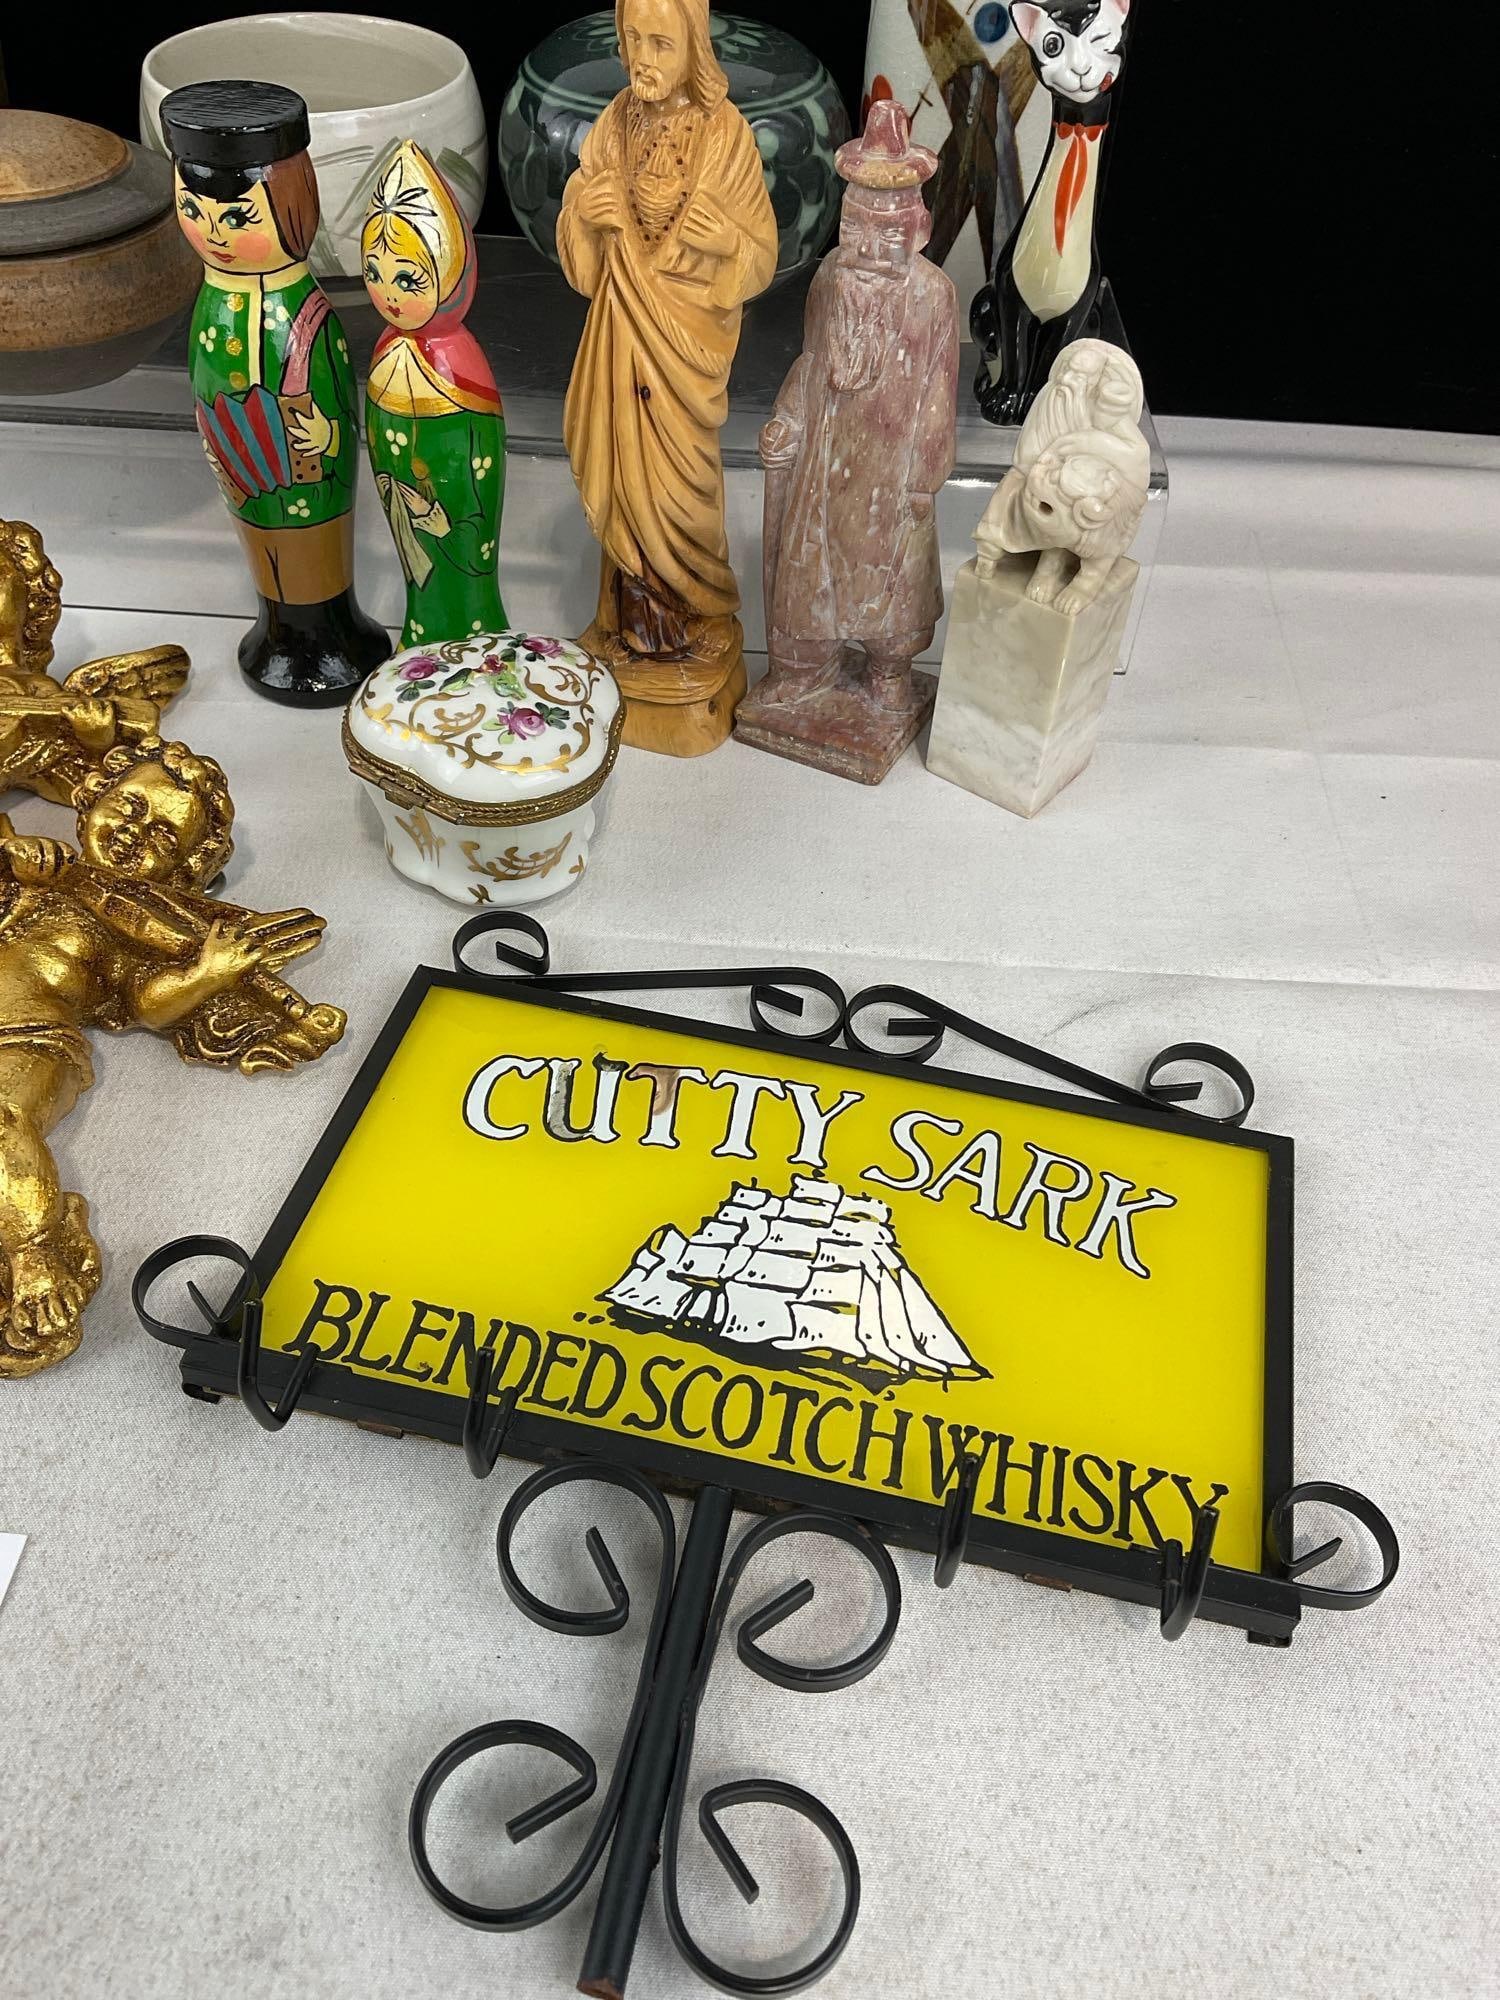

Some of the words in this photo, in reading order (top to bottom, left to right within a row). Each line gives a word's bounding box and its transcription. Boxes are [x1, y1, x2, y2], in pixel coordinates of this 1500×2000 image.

[461, 1051, 865, 1168] CUTTY
[859, 1110, 1178, 1279] SARK
[282, 1278, 627, 1419] BLENDED
[621, 1355, 913, 1490] SCOTCH
[922, 1414, 1229, 1556] WHISKY
